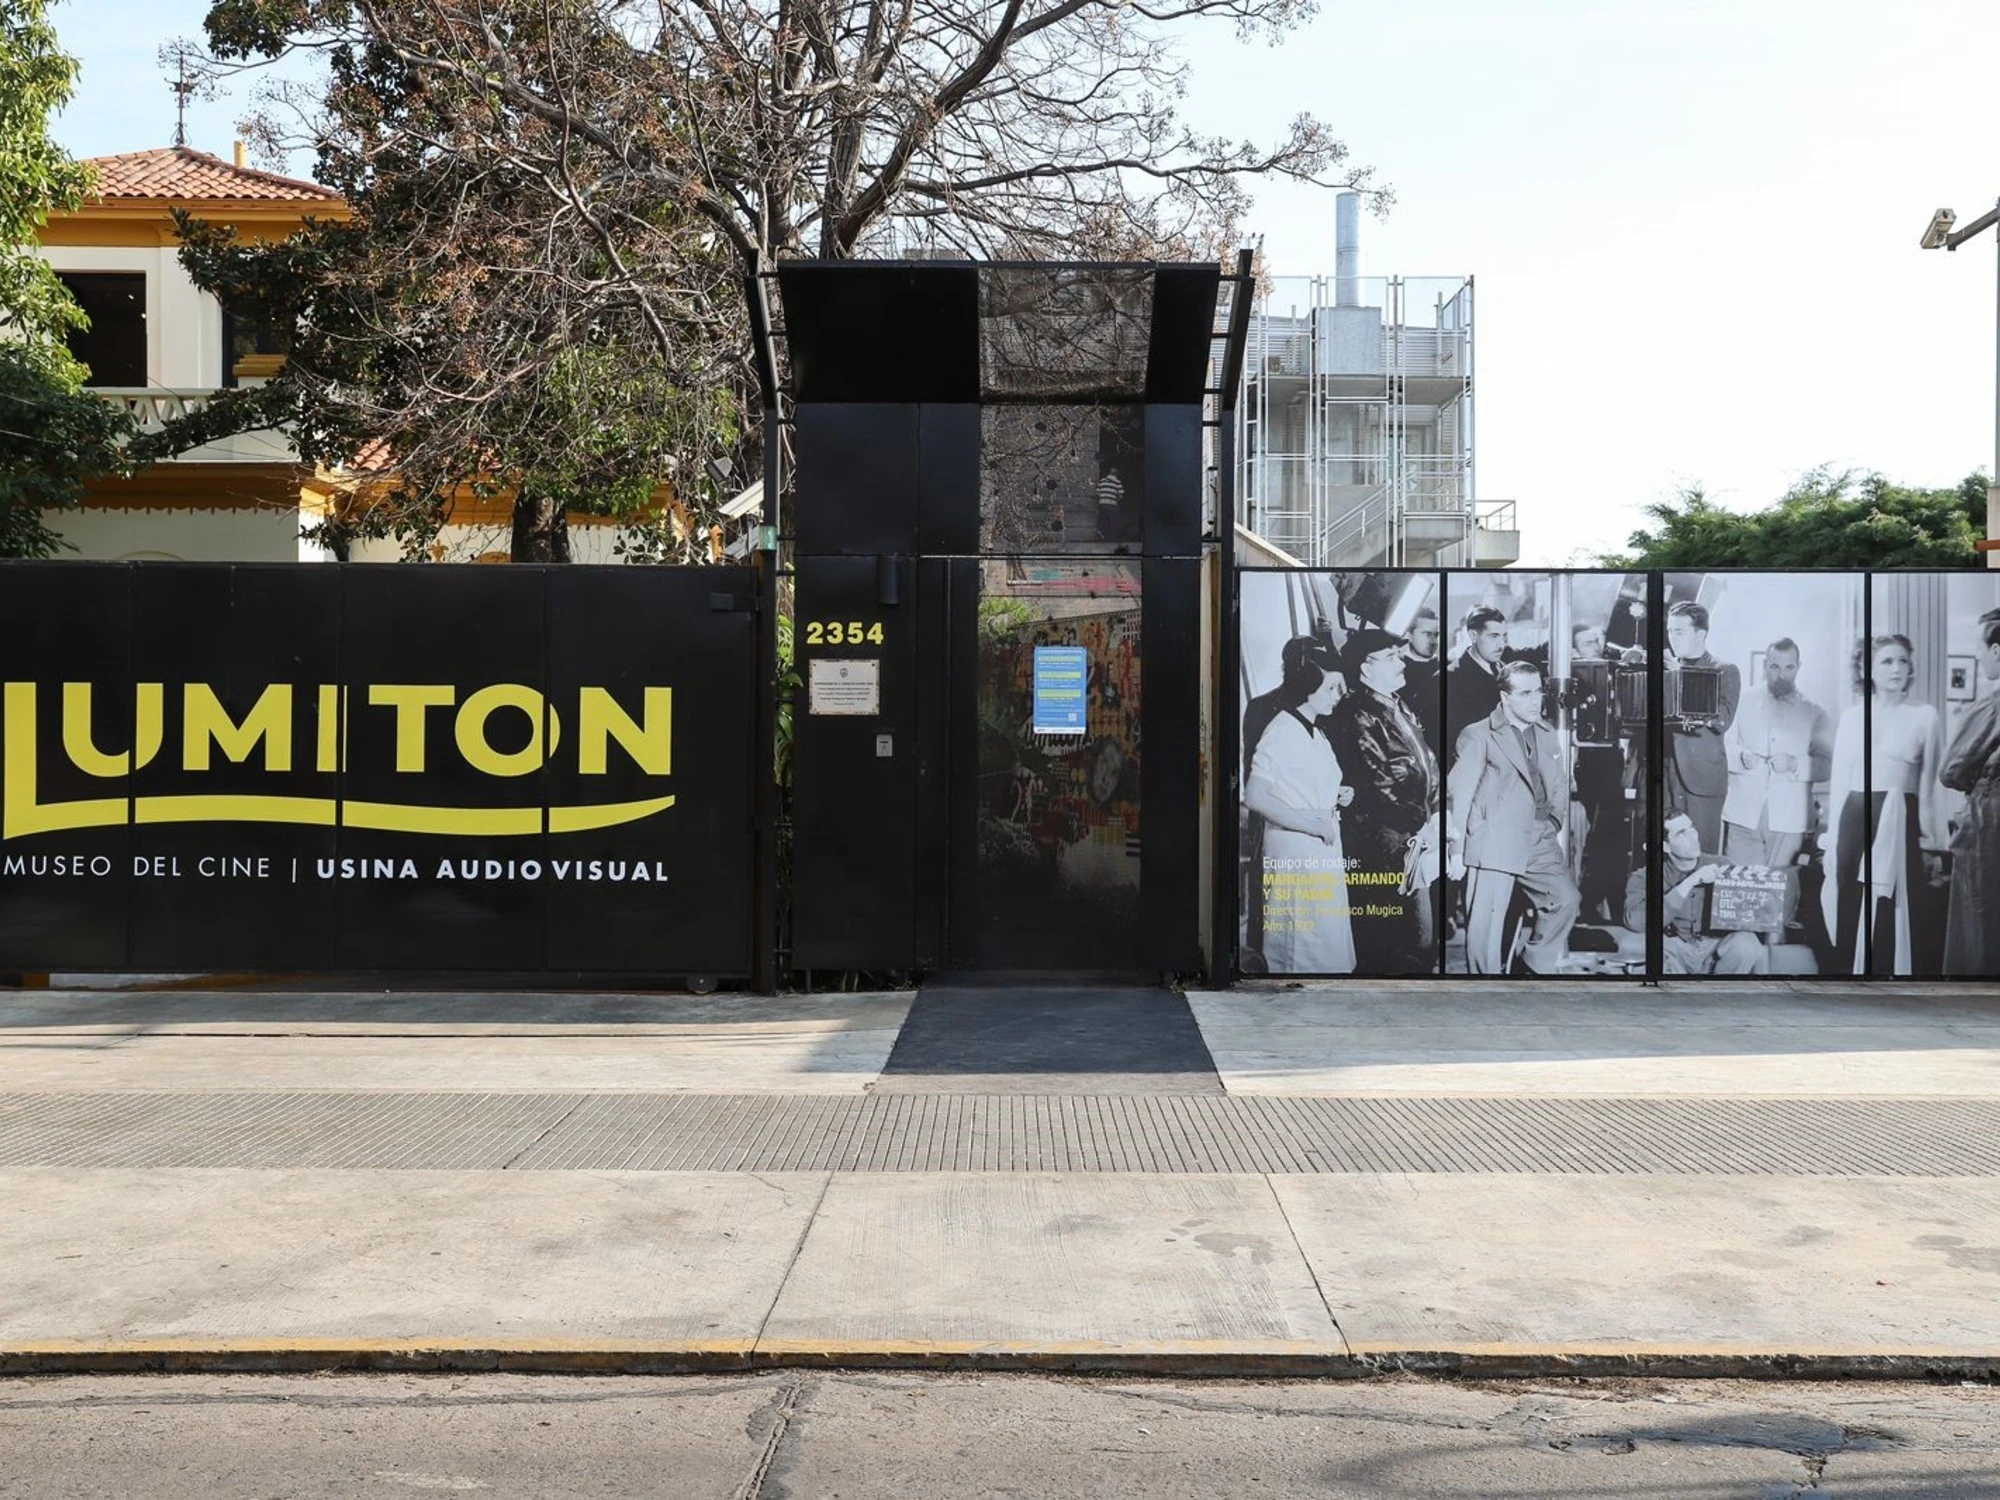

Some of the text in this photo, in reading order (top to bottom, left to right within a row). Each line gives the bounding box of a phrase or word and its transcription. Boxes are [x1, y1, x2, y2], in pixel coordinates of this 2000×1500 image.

[806, 621, 884, 645] 2354
[3, 681, 674, 840] LUMITON
[3, 855, 111, 876] MUSEO
[134, 856, 181, 876] DEL
[199, 856, 270, 878] CINE
[317, 858, 419, 879] USINA
[1263, 856, 1361, 871] Equipo de rodaje:
[1343, 871, 1406, 885] ARMANDO
[1263, 888, 1334, 901] Y SU PAD
[1366, 903, 1404, 918] Mugica
